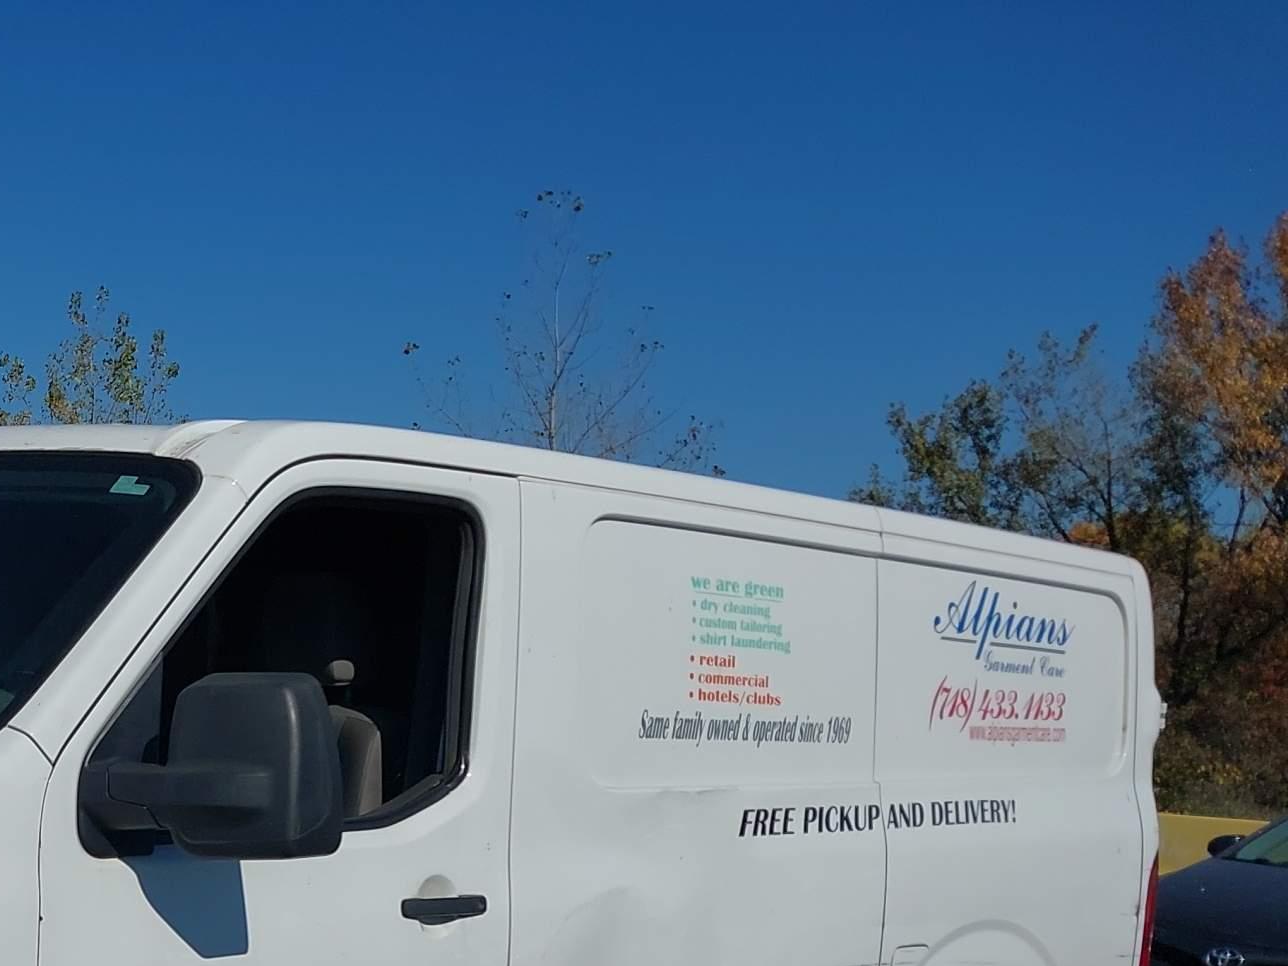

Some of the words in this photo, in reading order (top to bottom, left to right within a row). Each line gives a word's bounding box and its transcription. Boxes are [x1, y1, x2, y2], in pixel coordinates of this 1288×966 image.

[691, 576, 710, 589] we
[715, 578, 740, 593] are
[744, 581, 784, 598] green
[700, 599, 718, 614] dry
[723, 601, 771, 619] cleaning
[699, 616, 737, 631] custom
[741, 619, 783, 637] tailoring
[934, 580, 1076, 660] Alpians
[699, 632, 727, 646] shirt
[731, 635, 791, 654] laundering
[699, 655, 736, 668] retail
[1040, 656, 1065, 677] Care
[698, 673, 769, 688] commercial
[698, 688, 782, 706] hotels/clubs
[929, 675, 977, 732] (718)
[639, 709, 670, 740] Same
[672, 711, 706, 748] family
[707, 713, 742, 742] owned
[742, 713, 752, 742] &
[753, 715, 799, 749] operated
[798, 716, 823, 743] since
[827, 716, 852, 744] 1969
[739, 807, 796, 837] FREE
[803, 804, 880, 834] PICKUP
[887, 802, 924, 829] AND
[931, 799, 1016, 826] DELIVERY!
